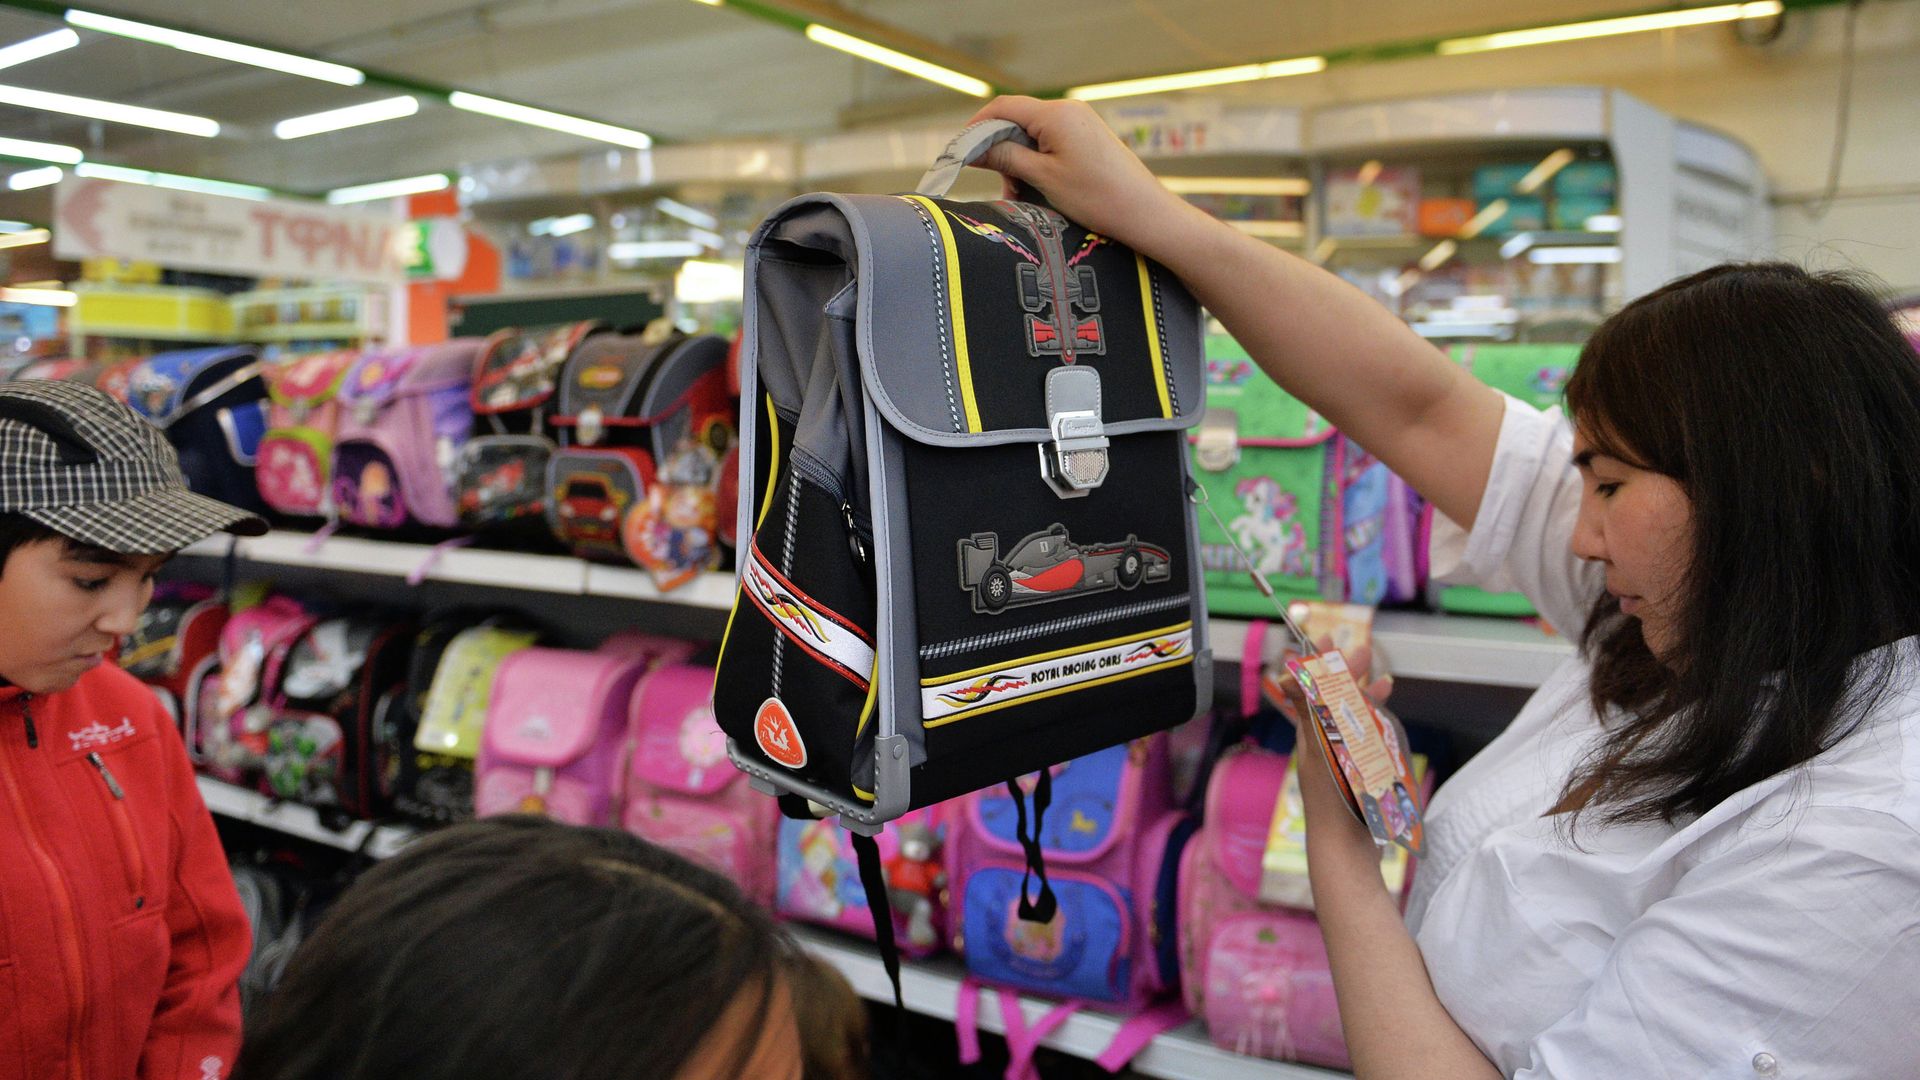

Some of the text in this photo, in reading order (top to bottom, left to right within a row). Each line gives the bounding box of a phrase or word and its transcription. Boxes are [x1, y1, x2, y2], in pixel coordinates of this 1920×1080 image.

[1031, 654, 1122, 684] ROYAL RACING CARS
